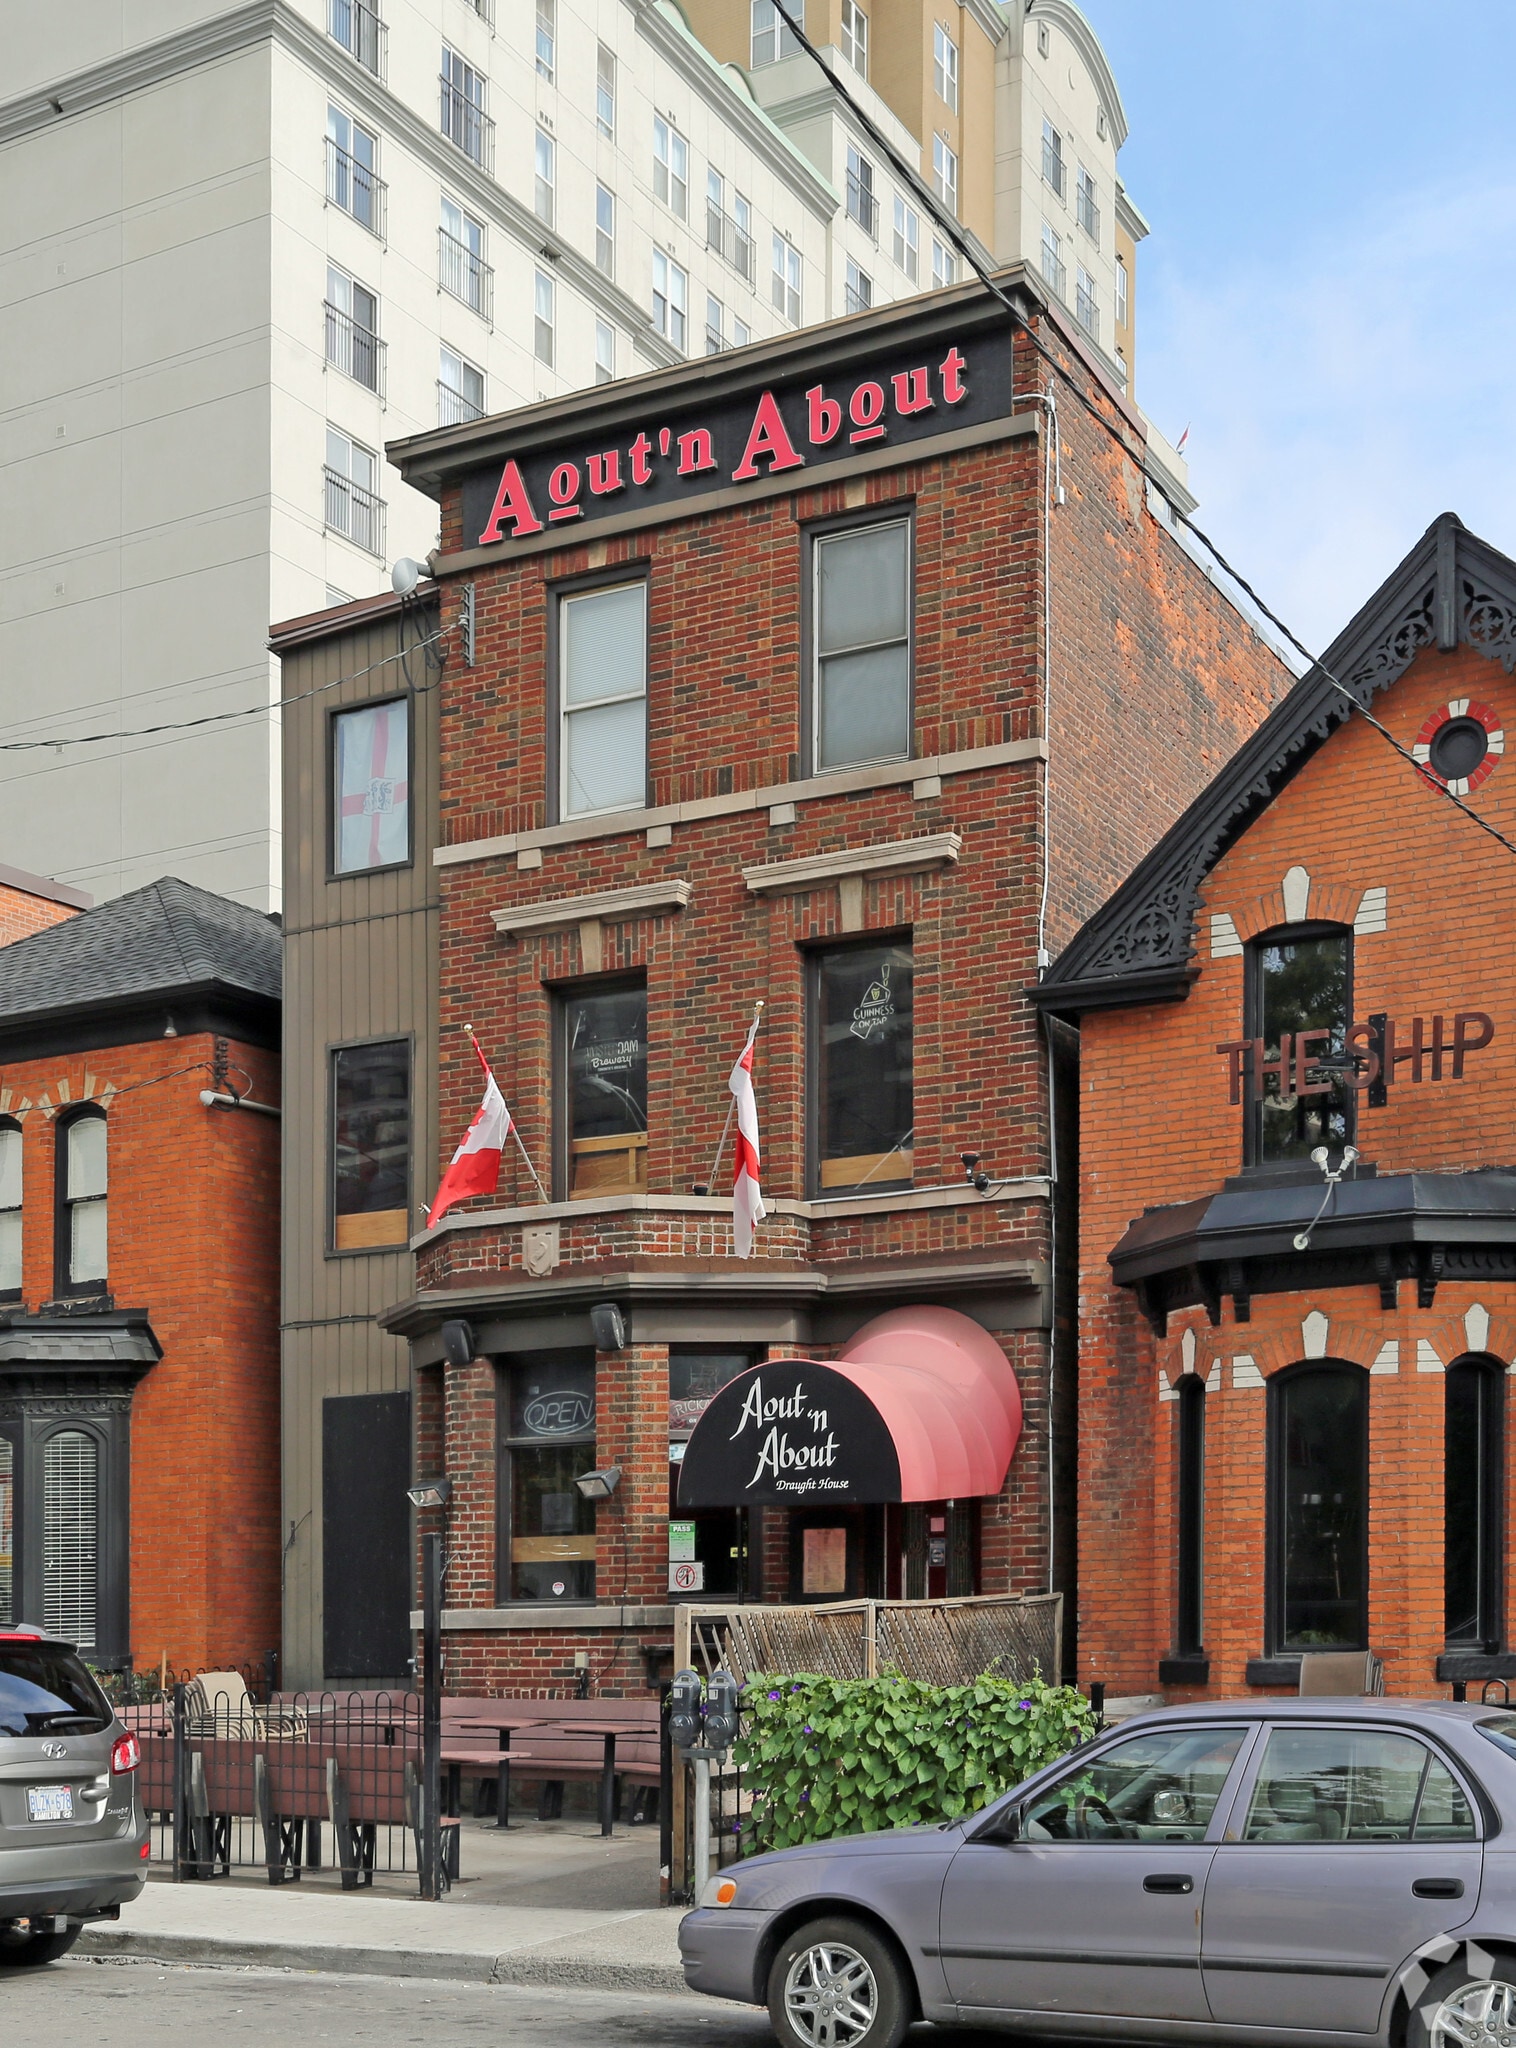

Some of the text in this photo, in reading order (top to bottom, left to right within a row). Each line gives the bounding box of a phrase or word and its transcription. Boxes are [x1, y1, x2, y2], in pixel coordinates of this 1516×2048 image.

[731, 346, 970, 482] About
[853, 1003, 895, 1020] GUINNESS
[858, 1016, 888, 1029] ON TAP
[585, 1039, 639, 1057] AMSTDAM
[590, 1055, 633, 1068] Brewery
[1215, 1012, 1495, 1105] THE SHIP
[527, 1399, 594, 1426] OPEN
[729, 1376, 809, 1441] Aout
[745, 1425, 841, 1489] About
[776, 1478, 850, 1494] Draught House
[672, 1525, 691, 1533] PASS
